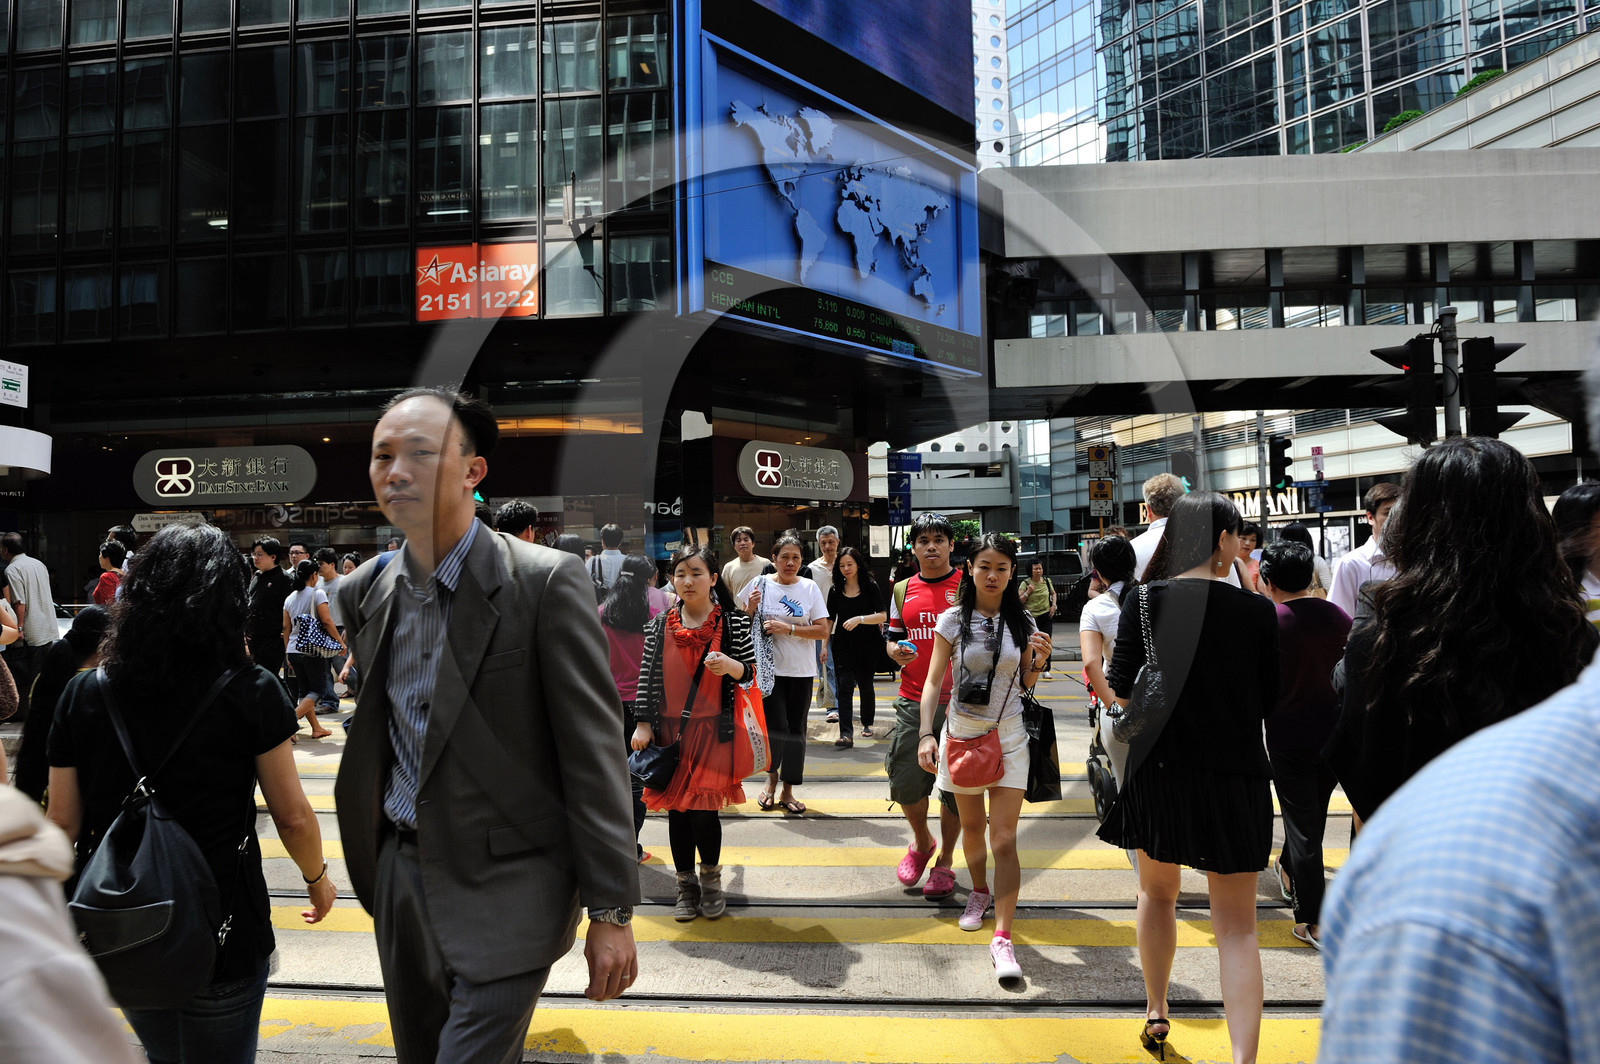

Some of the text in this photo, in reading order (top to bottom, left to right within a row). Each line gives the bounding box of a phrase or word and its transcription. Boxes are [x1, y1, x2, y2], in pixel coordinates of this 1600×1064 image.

[450, 260, 537, 286] Asiaray
[419, 289, 535, 312] 2151 1222
[711, 269, 734, 286] CCB
[817, 297, 838, 313] 5.110
[845, 305, 866, 321] 0.000
[869, 312, 893, 328] CHINA
[894, 318, 921, 336] MOBILE
[711, 291, 755, 313] HENGAN
[757, 304, 781, 319] INT'L
[870, 331, 893, 346] CHINA
[197, 456, 290, 478] 大新銀行
[783, 453, 840, 477] 大新銀行
[197, 478, 290, 495] DAH SING BANK
[820, 478, 841, 492] BANK
[1223, 486, 1300, 518] RMANI
